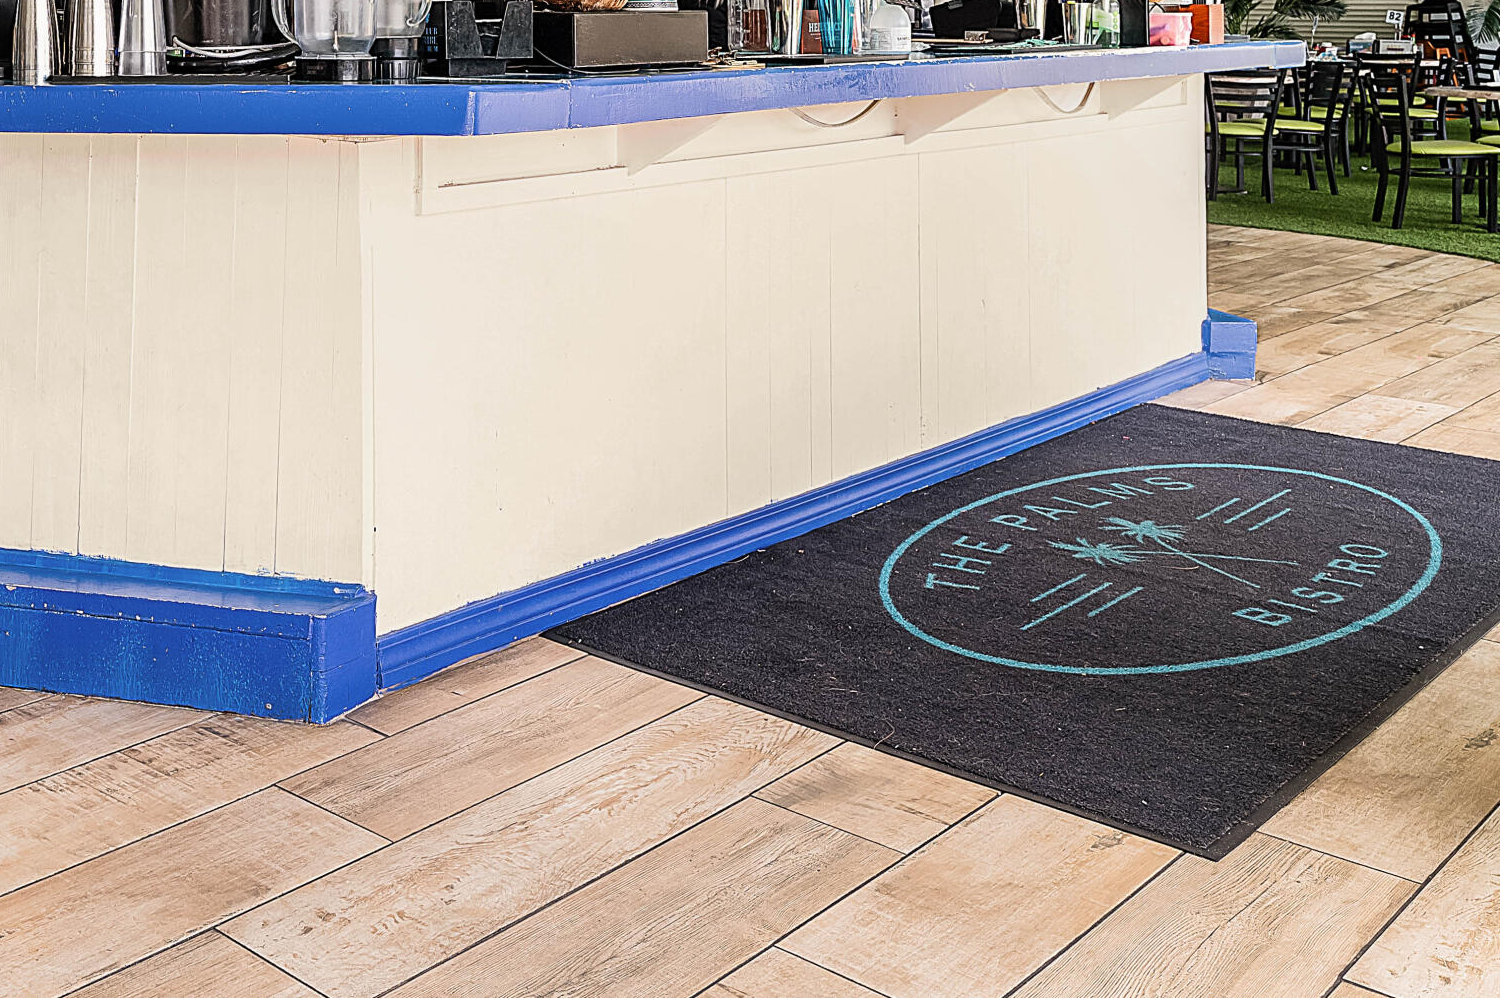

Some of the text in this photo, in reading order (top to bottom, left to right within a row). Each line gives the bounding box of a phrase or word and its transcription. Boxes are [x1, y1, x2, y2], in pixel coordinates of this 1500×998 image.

[1389, 11, 1402, 22] 82
[923, 475, 1197, 592] THE PALMS
[1231, 542, 1390, 628] BISTRO
